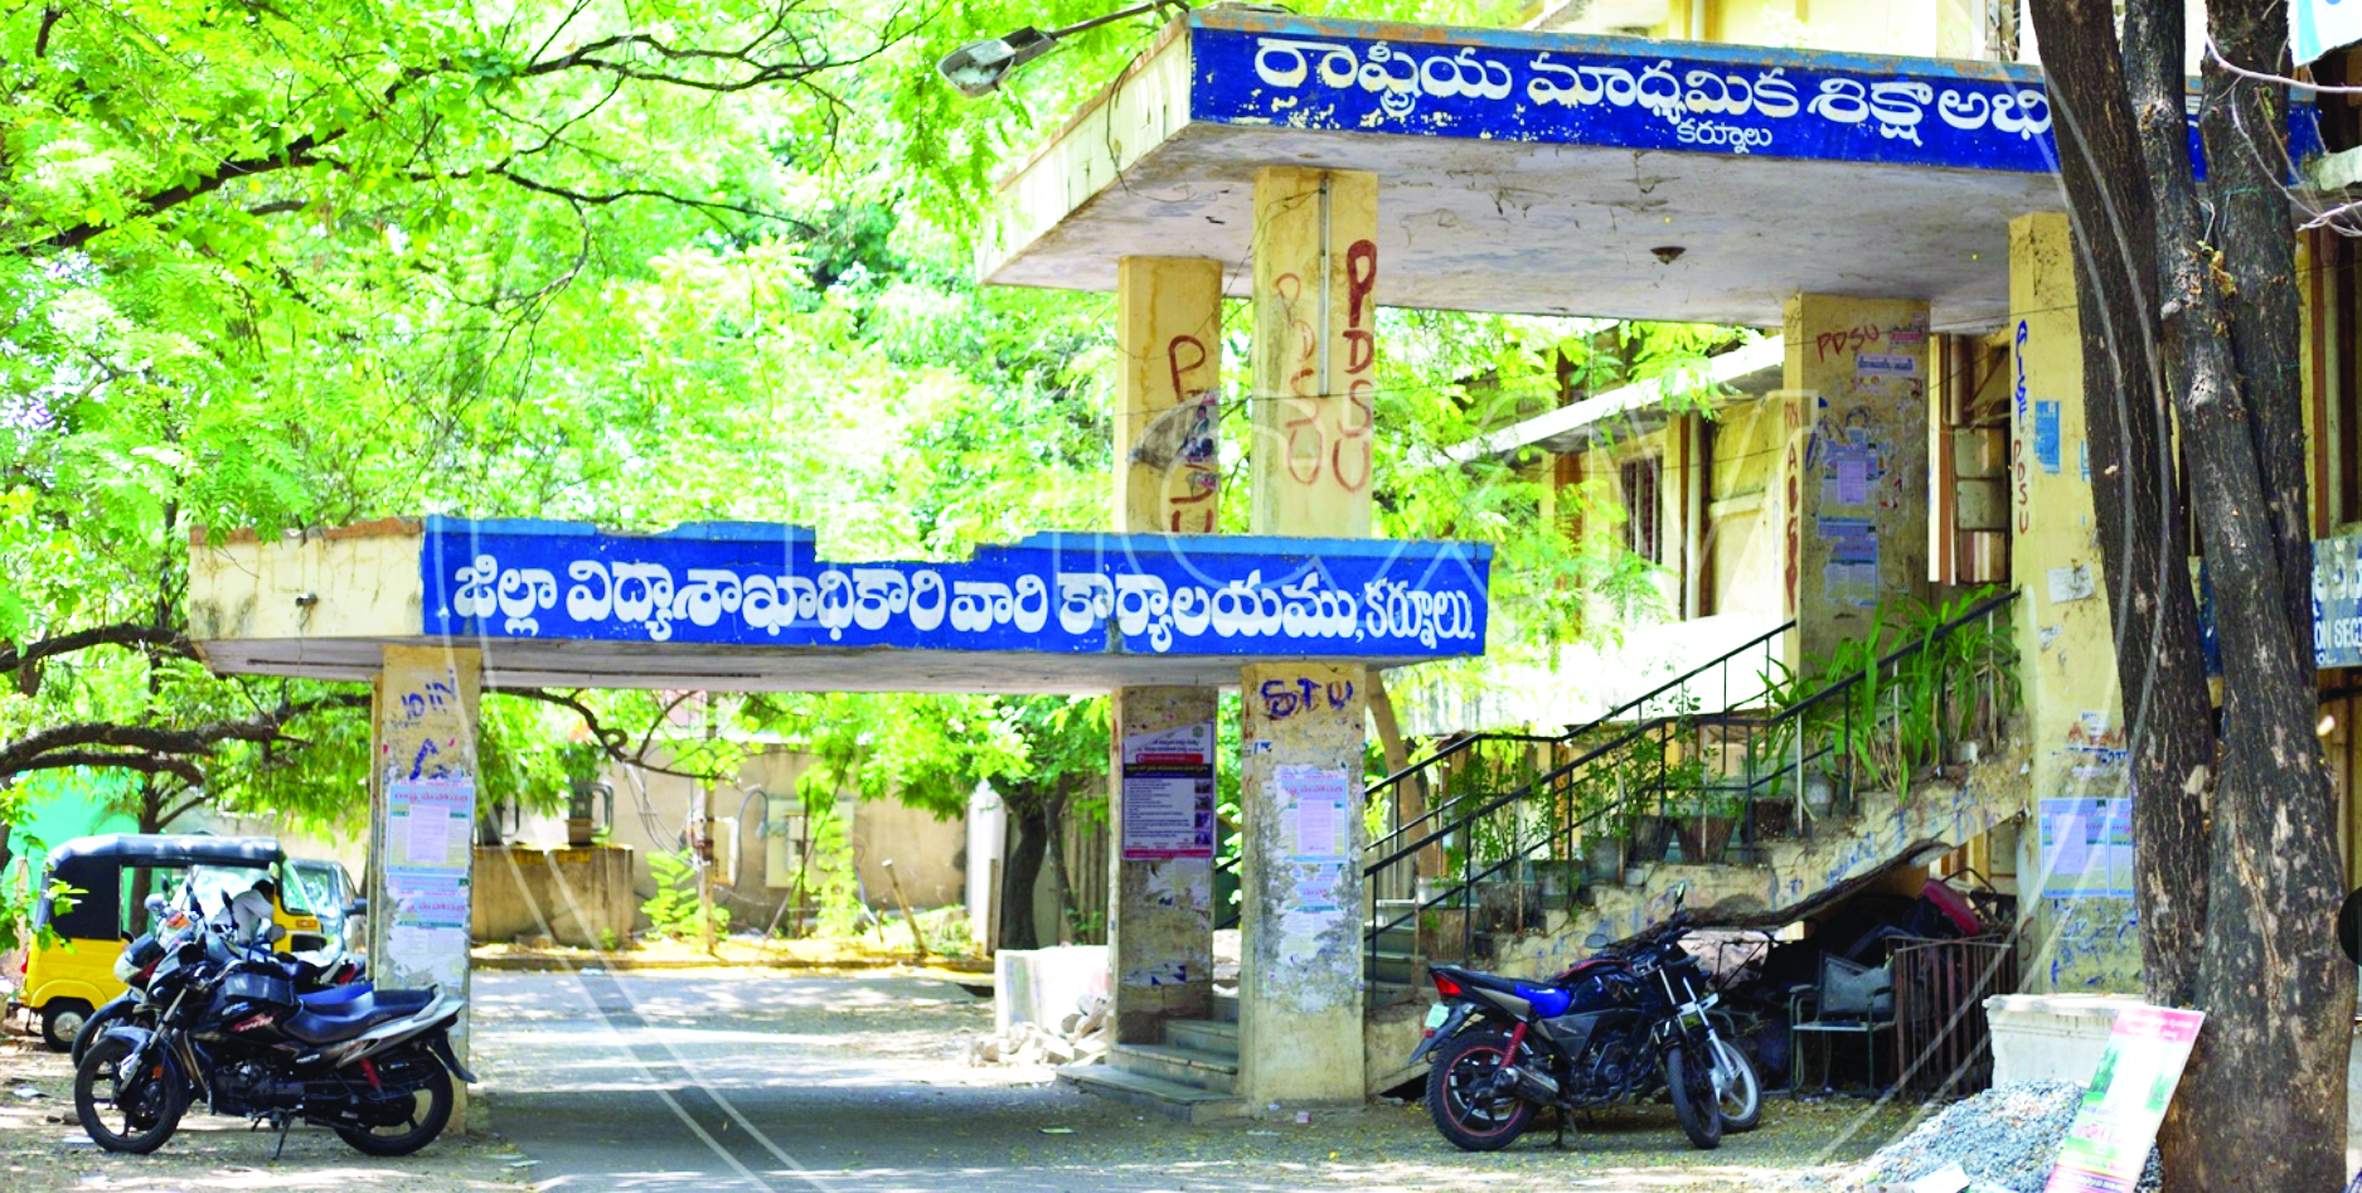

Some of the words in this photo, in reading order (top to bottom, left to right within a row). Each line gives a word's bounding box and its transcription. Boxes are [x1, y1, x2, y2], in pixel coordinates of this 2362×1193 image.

[1254, 38, 1513, 118] రాష్ట్రీయ
[1527, 52, 1800, 126] మాధ్యమిక
[1333, 239, 1377, 494] PDSU
[1816, 323, 1880, 363] PDSU
[453, 554, 558, 637] జిల్లా
[950, 574, 1048, 633] వారి
[1260, 678, 1354, 718] STU
